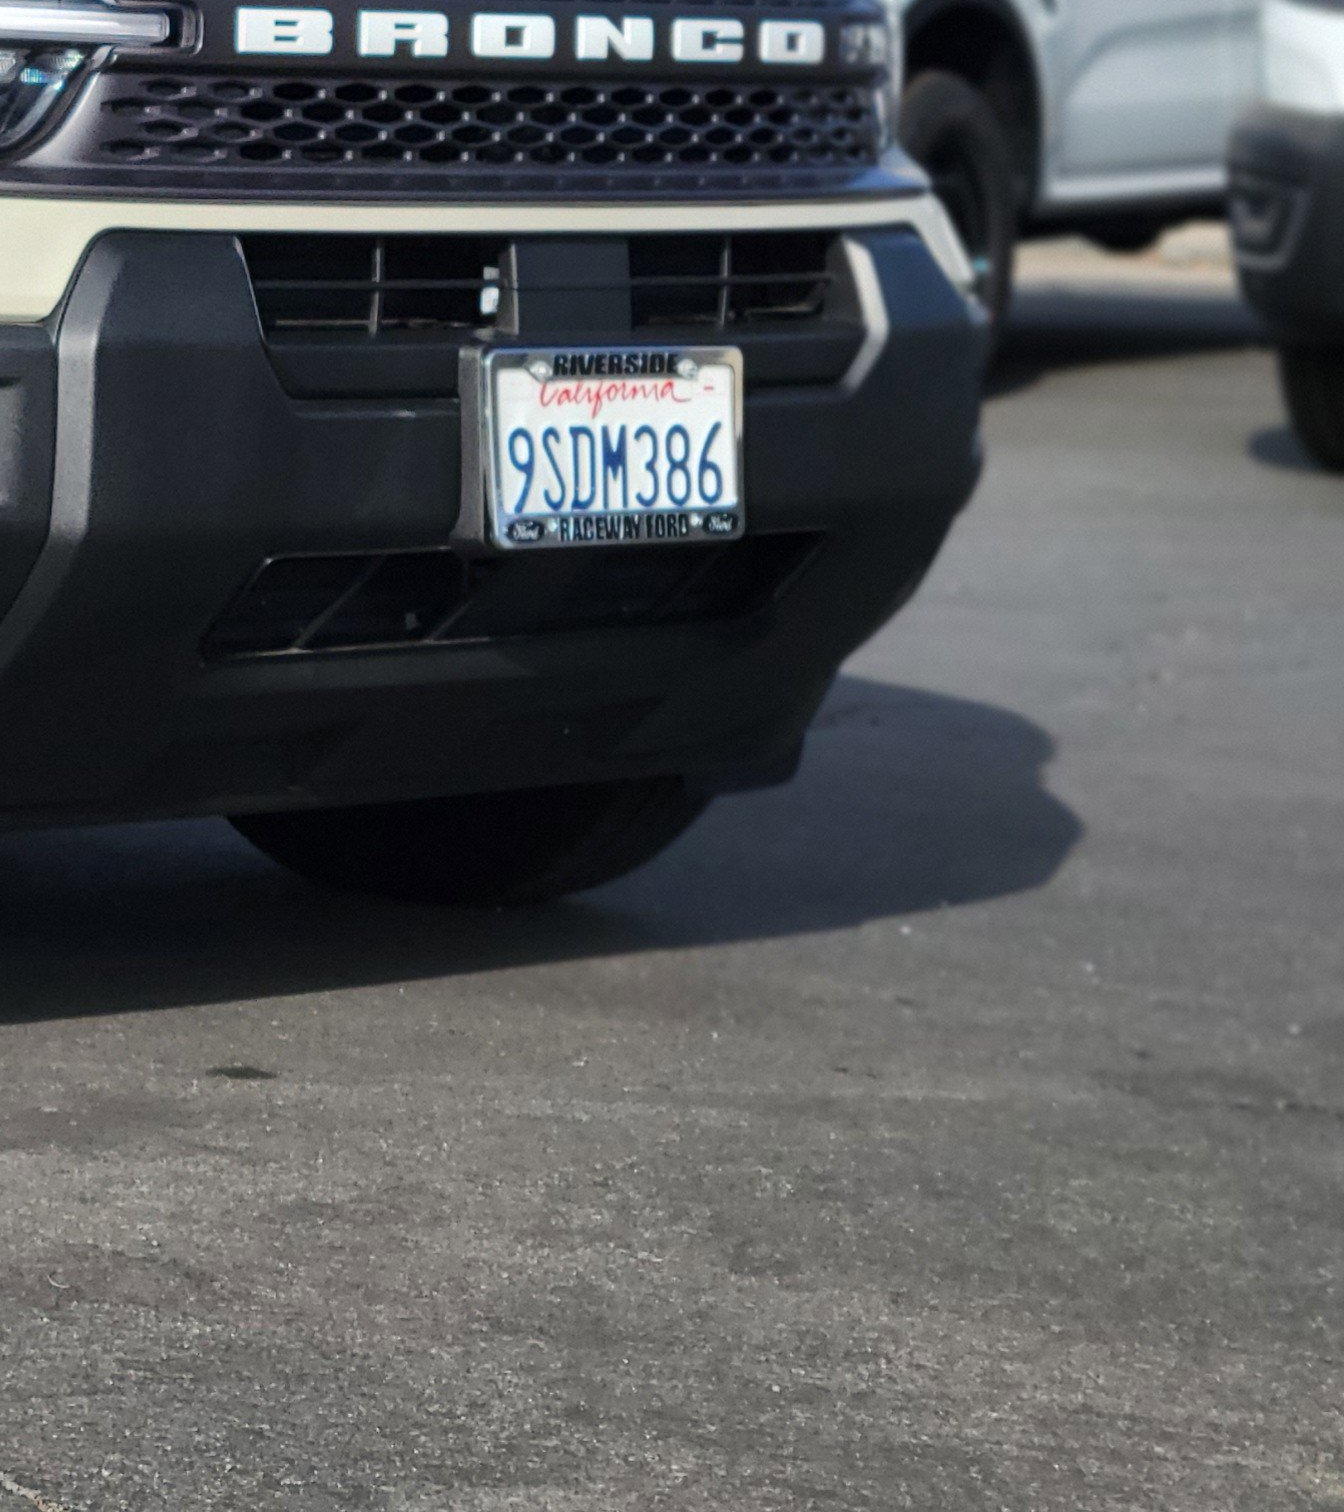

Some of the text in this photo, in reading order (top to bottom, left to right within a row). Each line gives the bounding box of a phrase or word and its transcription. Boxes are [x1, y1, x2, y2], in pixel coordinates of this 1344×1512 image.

[235, 6, 825, 64] BRONCO
[553, 354, 679, 375] RIVERSIDE
[540, 378, 691, 419] California
[508, 422, 723, 513] 9SDM386
[559, 513, 690, 541] RACEWAY FORD
